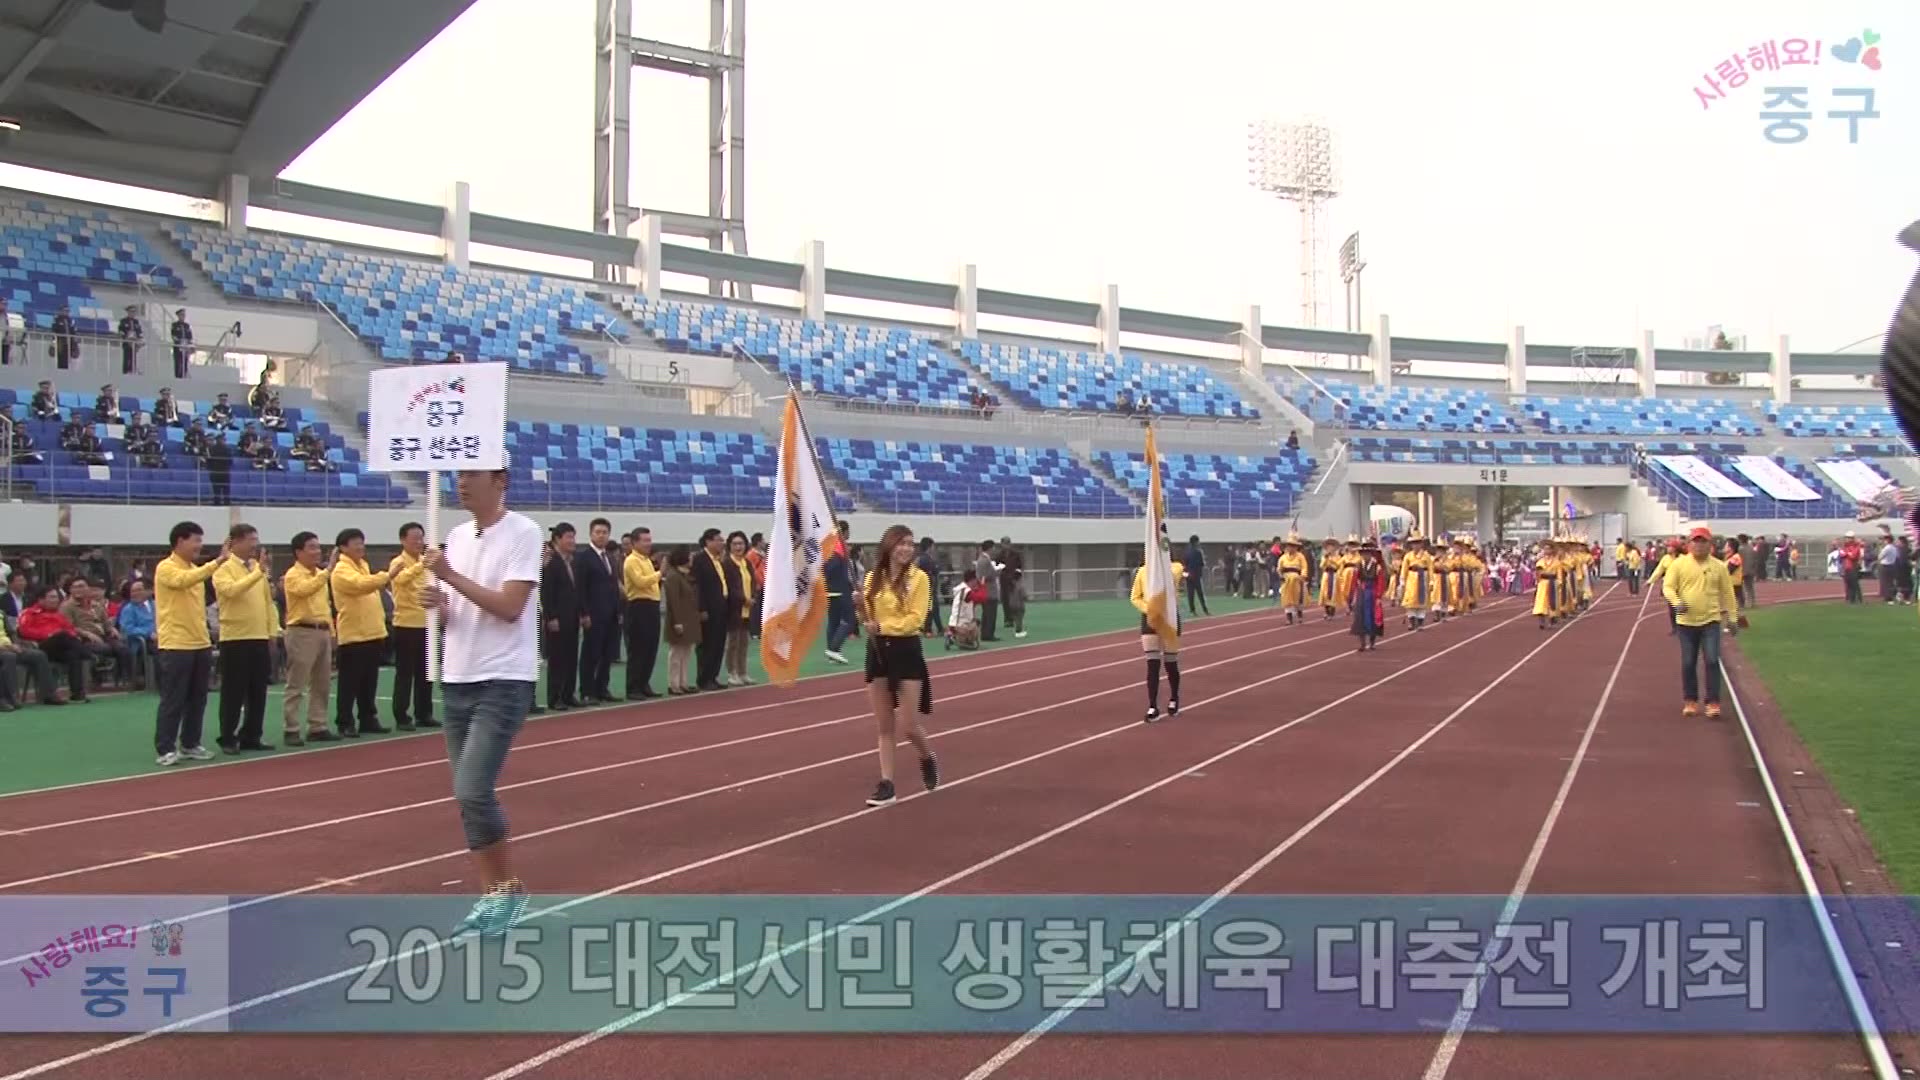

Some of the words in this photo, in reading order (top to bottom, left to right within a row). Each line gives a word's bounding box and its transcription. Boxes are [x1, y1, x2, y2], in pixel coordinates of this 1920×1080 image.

[669, 361, 678, 375] 5
[427, 400, 464, 427] 중구
[388, 437, 421, 461] 중구
[428, 435, 481, 460] 선수단
